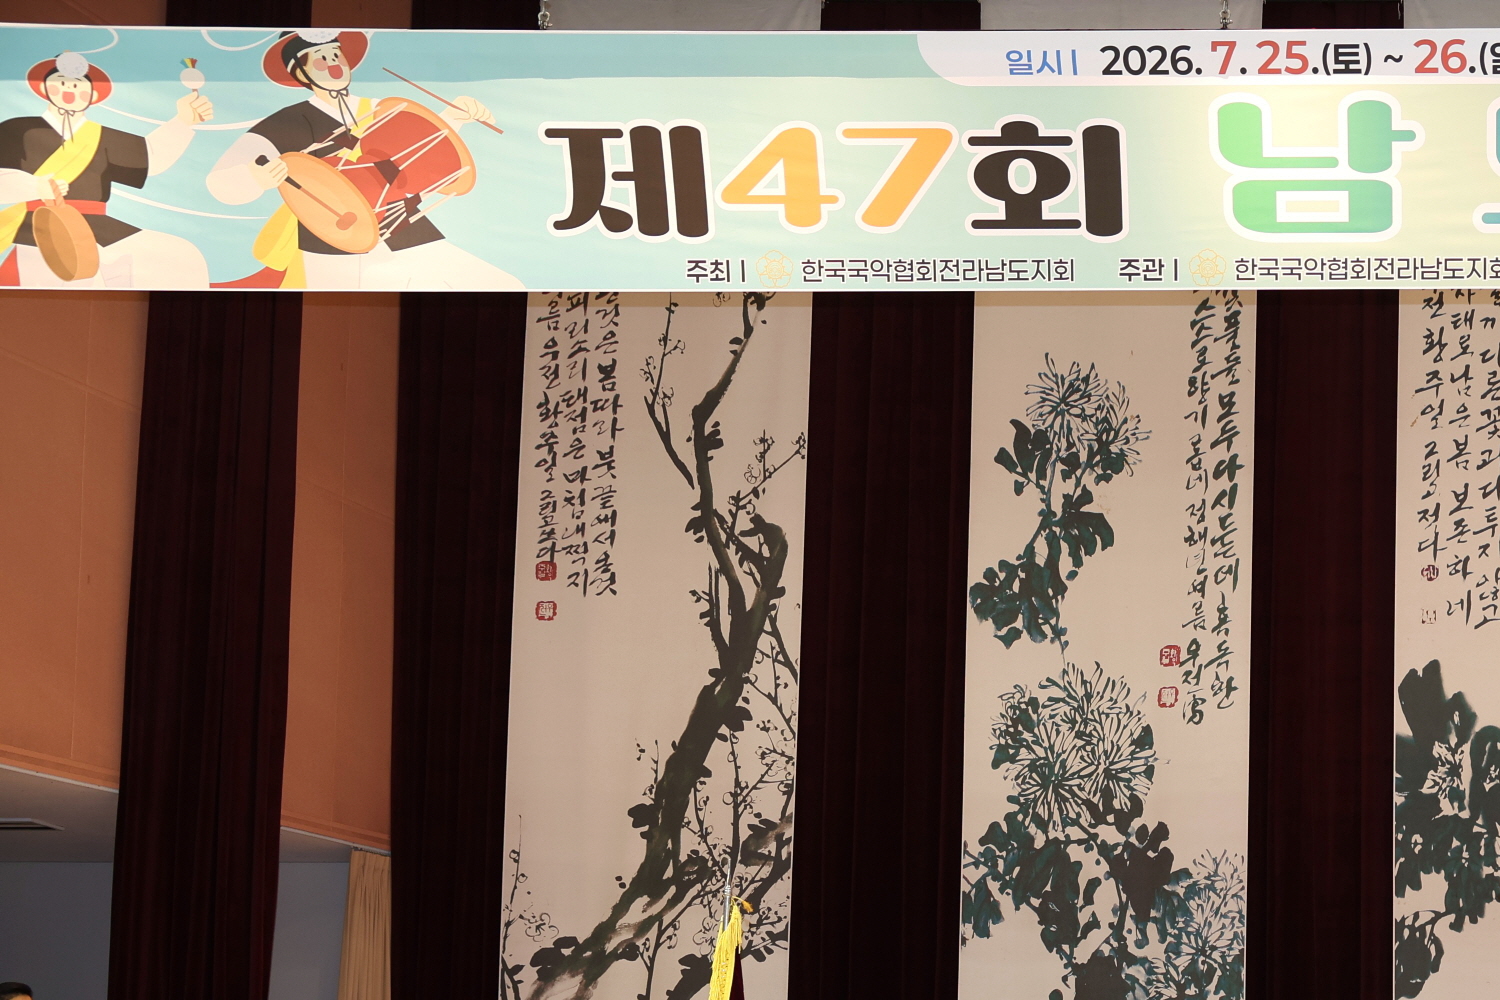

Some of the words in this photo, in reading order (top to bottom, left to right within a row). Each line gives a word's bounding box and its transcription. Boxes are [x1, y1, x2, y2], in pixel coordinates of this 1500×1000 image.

[1007, 51, 1061, 74] 일시
[543, 118, 1127, 240] 제47회
[687, 260, 730, 283] 주최
[802, 259, 1073, 282] 한국국악협회전라남도지회
[1120, 259, 1164, 281] 주관
